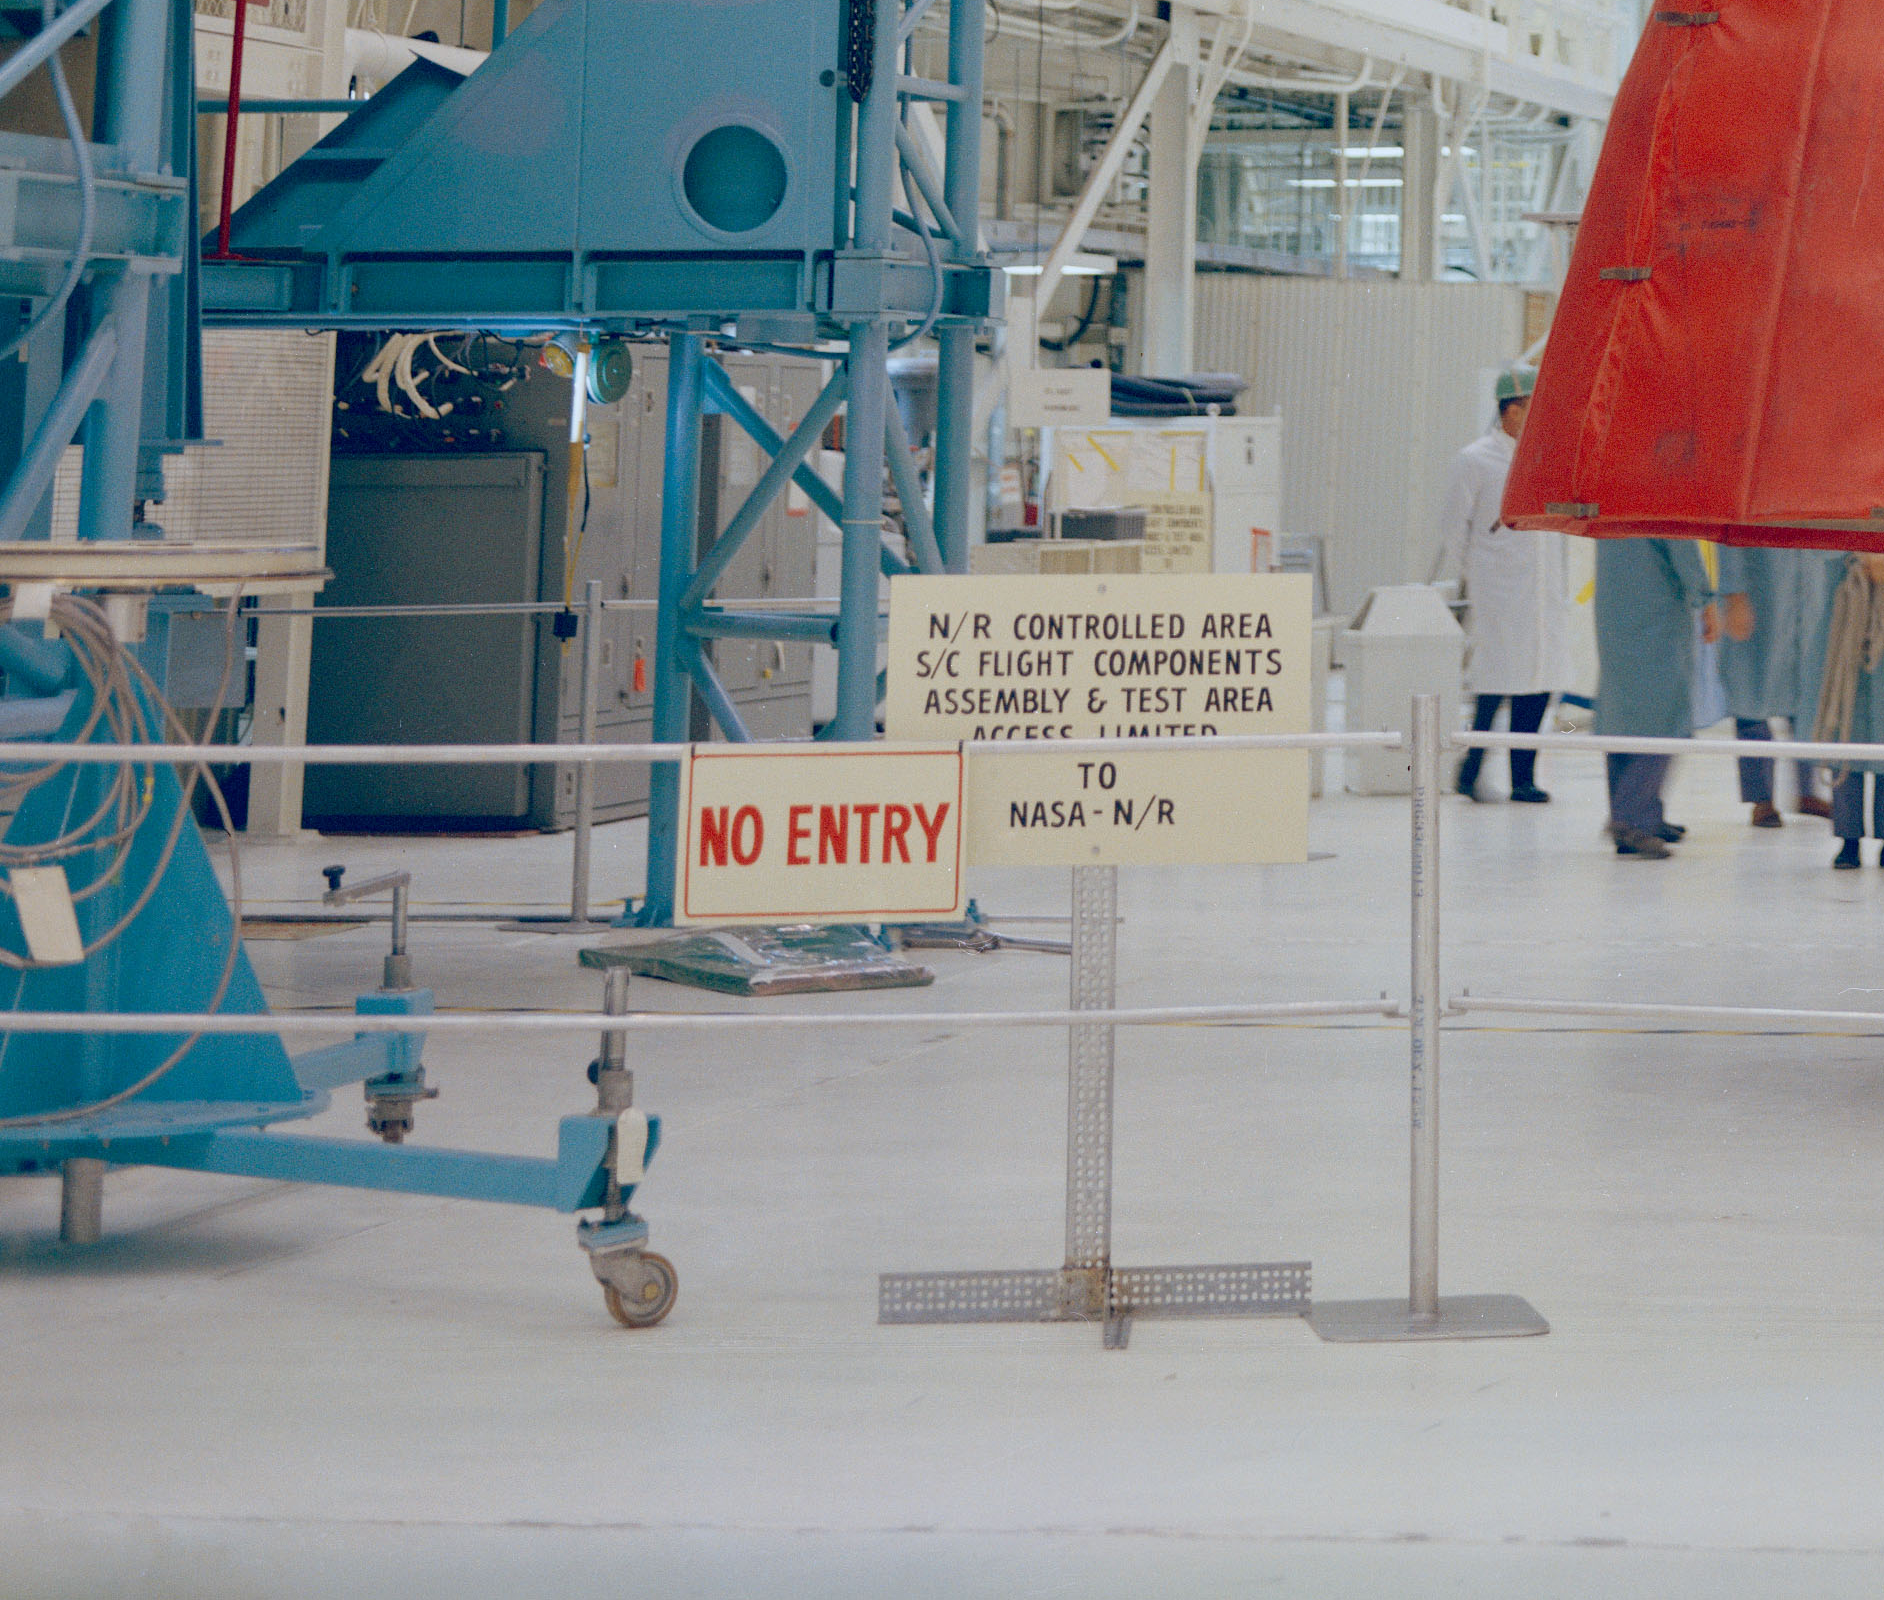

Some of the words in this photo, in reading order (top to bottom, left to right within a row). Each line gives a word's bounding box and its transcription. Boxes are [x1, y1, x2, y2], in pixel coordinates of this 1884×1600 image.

[929, 612, 991, 644] N/R
[1013, 613, 1185, 640] CONTROLLED
[1201, 613, 1273, 639] AREA
[916, 649, 959, 679] S/C
[979, 650, 1074, 677] FLIGHT
[1094, 648, 1282, 677] COMPONENTS
[924, 687, 1070, 715] ASSEMBLY
[1087, 688, 1107, 713] &
[1120, 687, 1187, 713] TEST
[1204, 687, 1274, 713] AREA
[1078, 762, 1117, 790] TO
[699, 804, 764, 867] NO
[787, 802, 950, 866] ENTRY
